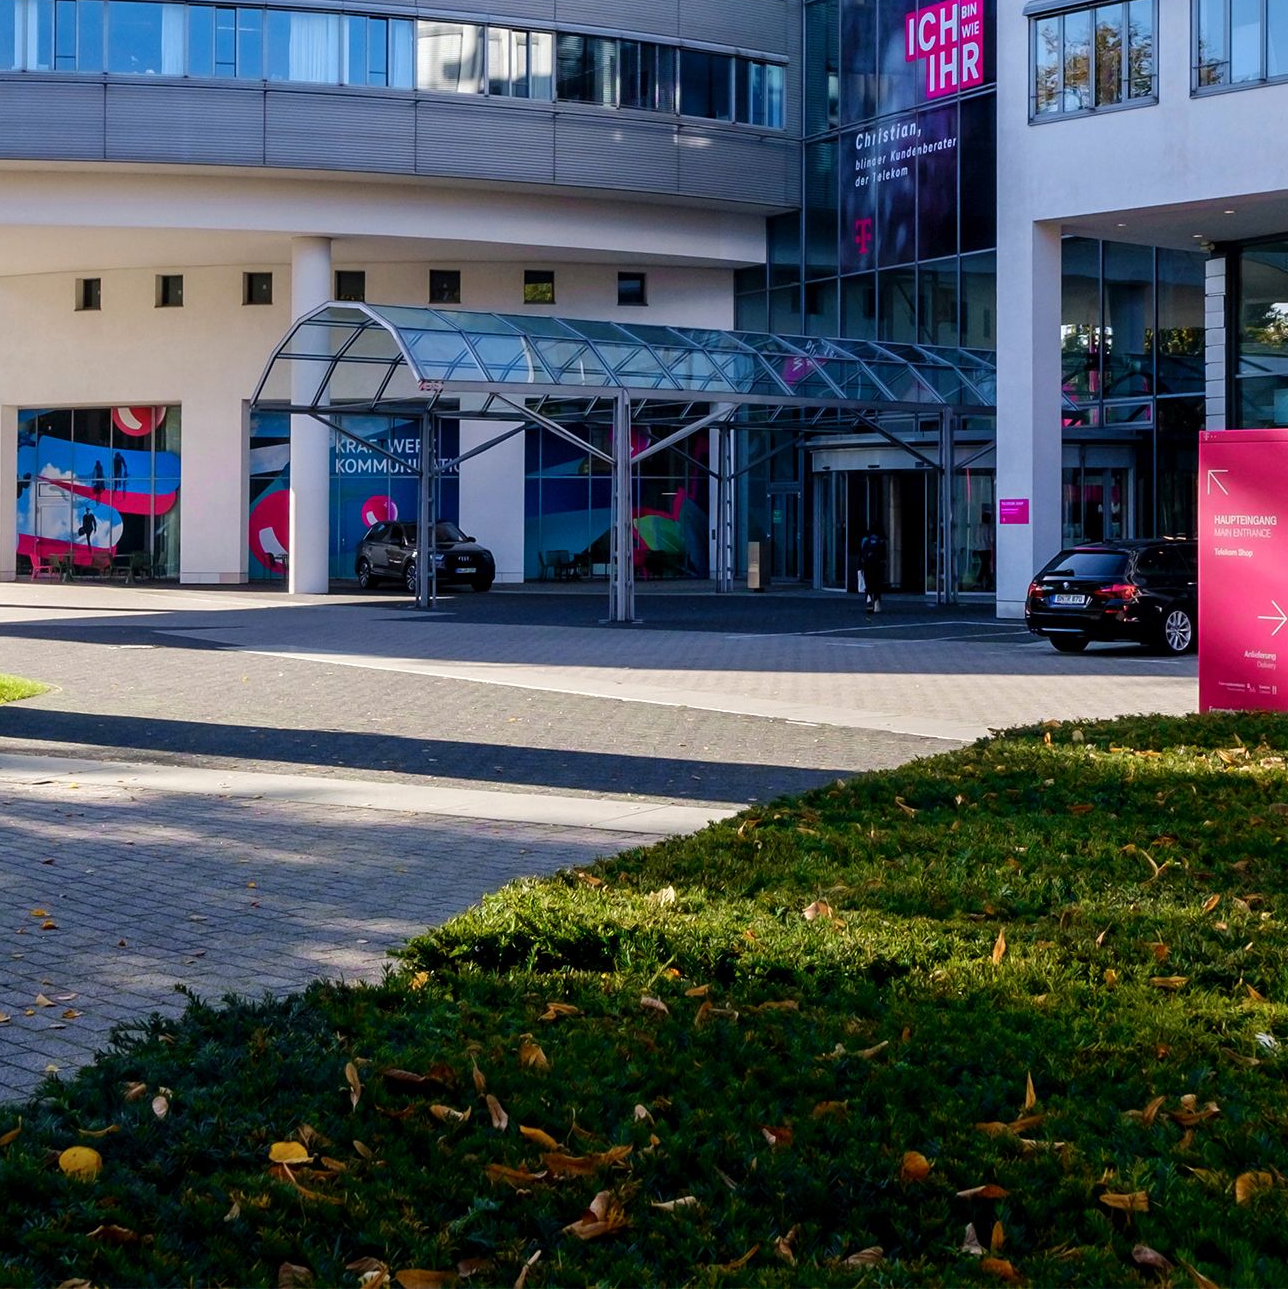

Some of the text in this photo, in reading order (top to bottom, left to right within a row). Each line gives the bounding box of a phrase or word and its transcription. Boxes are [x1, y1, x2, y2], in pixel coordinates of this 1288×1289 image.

[961, 1, 977, 19] BIN
[909, 3, 958, 56] ICH
[961, 20, 980, 38] WIE
[929, 41, 980, 92] IHR
[855, 122, 922, 150] Christian,
[890, 137, 957, 161] Kundenberater
[855, 176, 870, 188] der
[1214, 515, 1277, 525] HAUPTEINGANG
[1214, 529, 1272, 538] MAIN ENTRANCE
[1214, 548, 1253, 558] Telekom Shop
